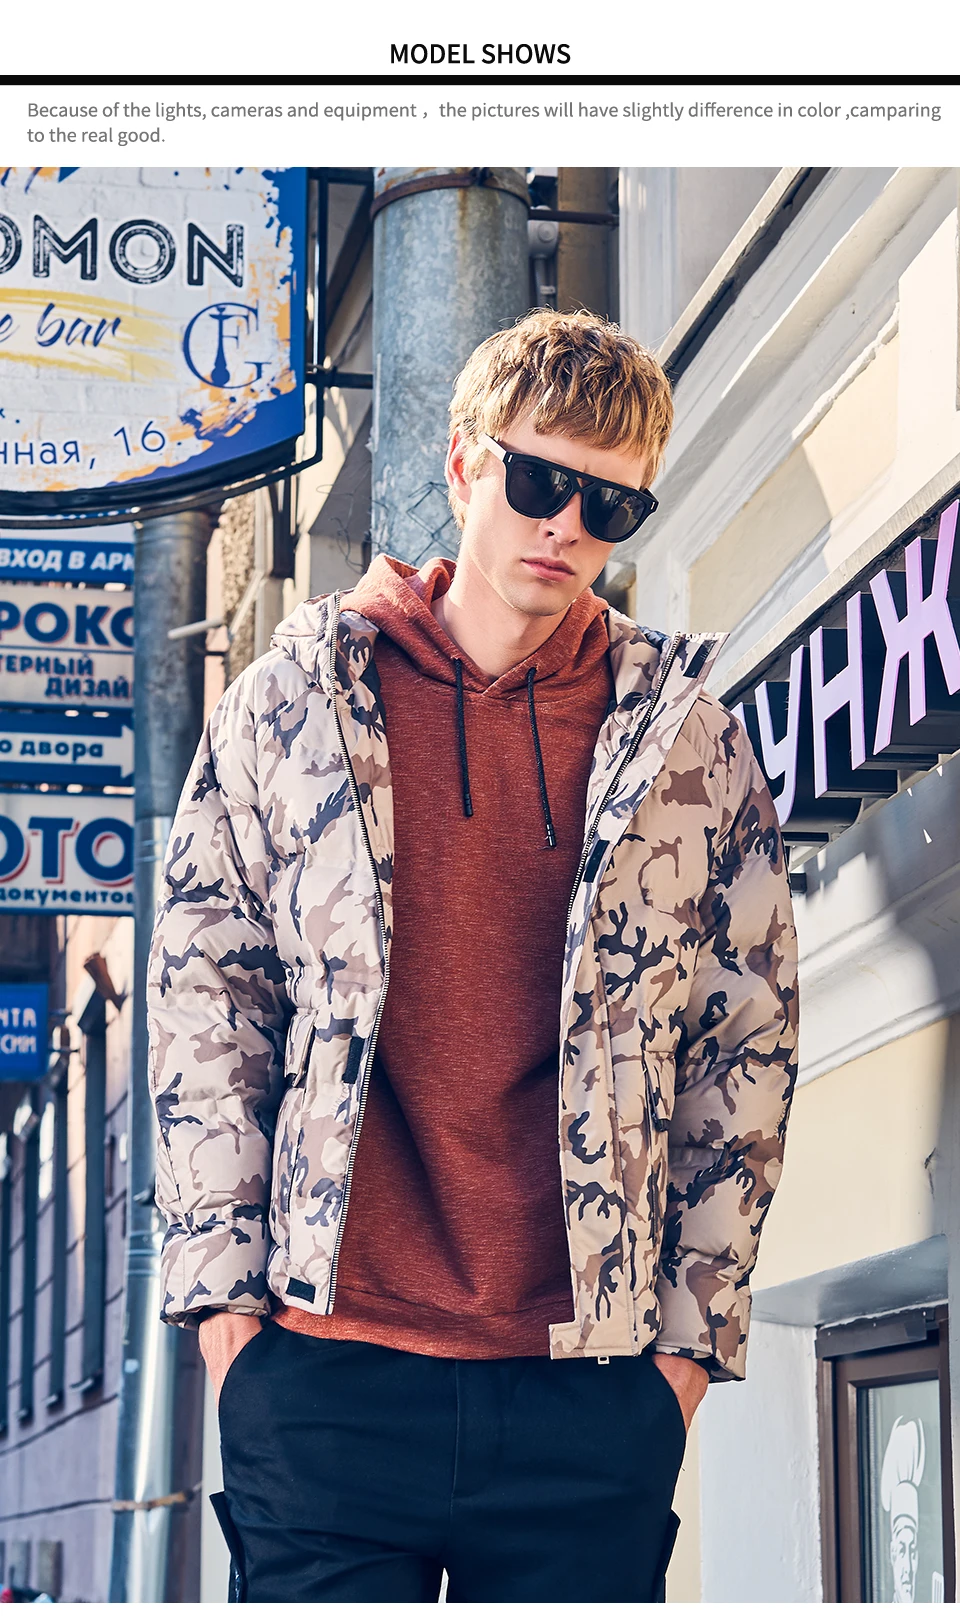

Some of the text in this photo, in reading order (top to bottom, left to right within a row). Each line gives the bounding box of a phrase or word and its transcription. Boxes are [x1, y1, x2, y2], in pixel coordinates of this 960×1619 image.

[35, 302, 121, 348] bar
[0, 547, 62, 572] ВХОД
[68, 550, 86, 570] В
[0, 652, 94, 676] ЕРНЫЙ
[730, 499, 960, 827] УНЖ
[20, 740, 103, 763] двора
